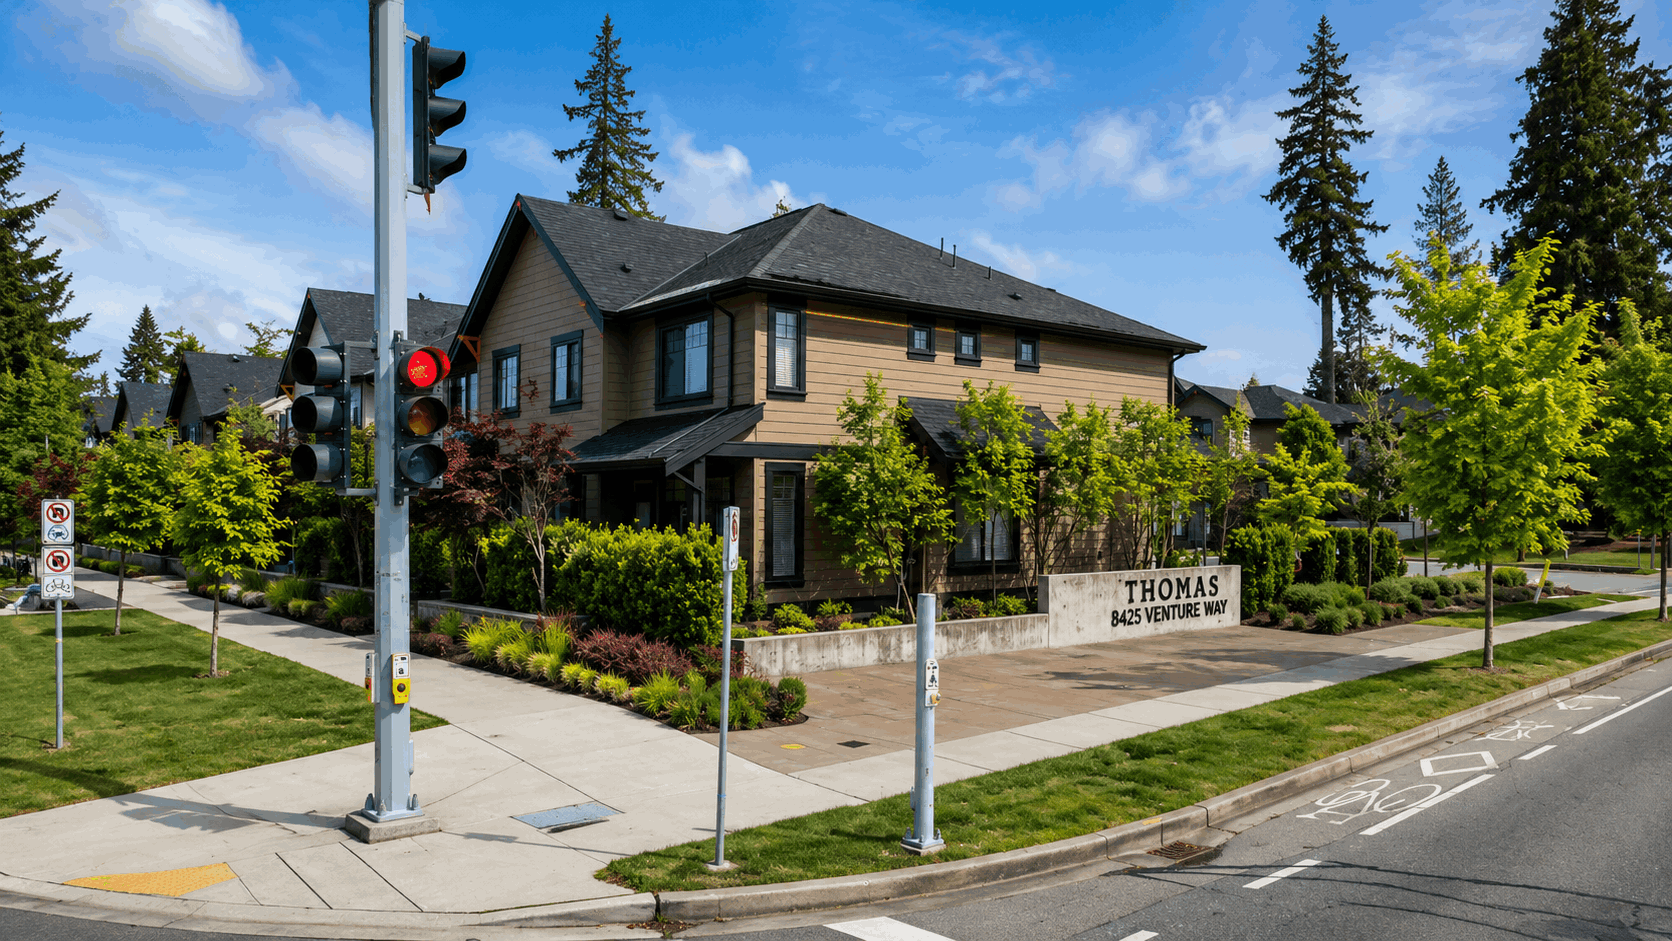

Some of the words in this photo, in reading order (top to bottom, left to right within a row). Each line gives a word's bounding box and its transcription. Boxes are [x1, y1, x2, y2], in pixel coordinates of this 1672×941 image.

[1125, 575, 1219, 604] THOMAS
[1111, 608, 1142, 627] 8425
[1145, 602, 1201, 623] VENTURE
[1203, 599, 1228, 616] WAY
